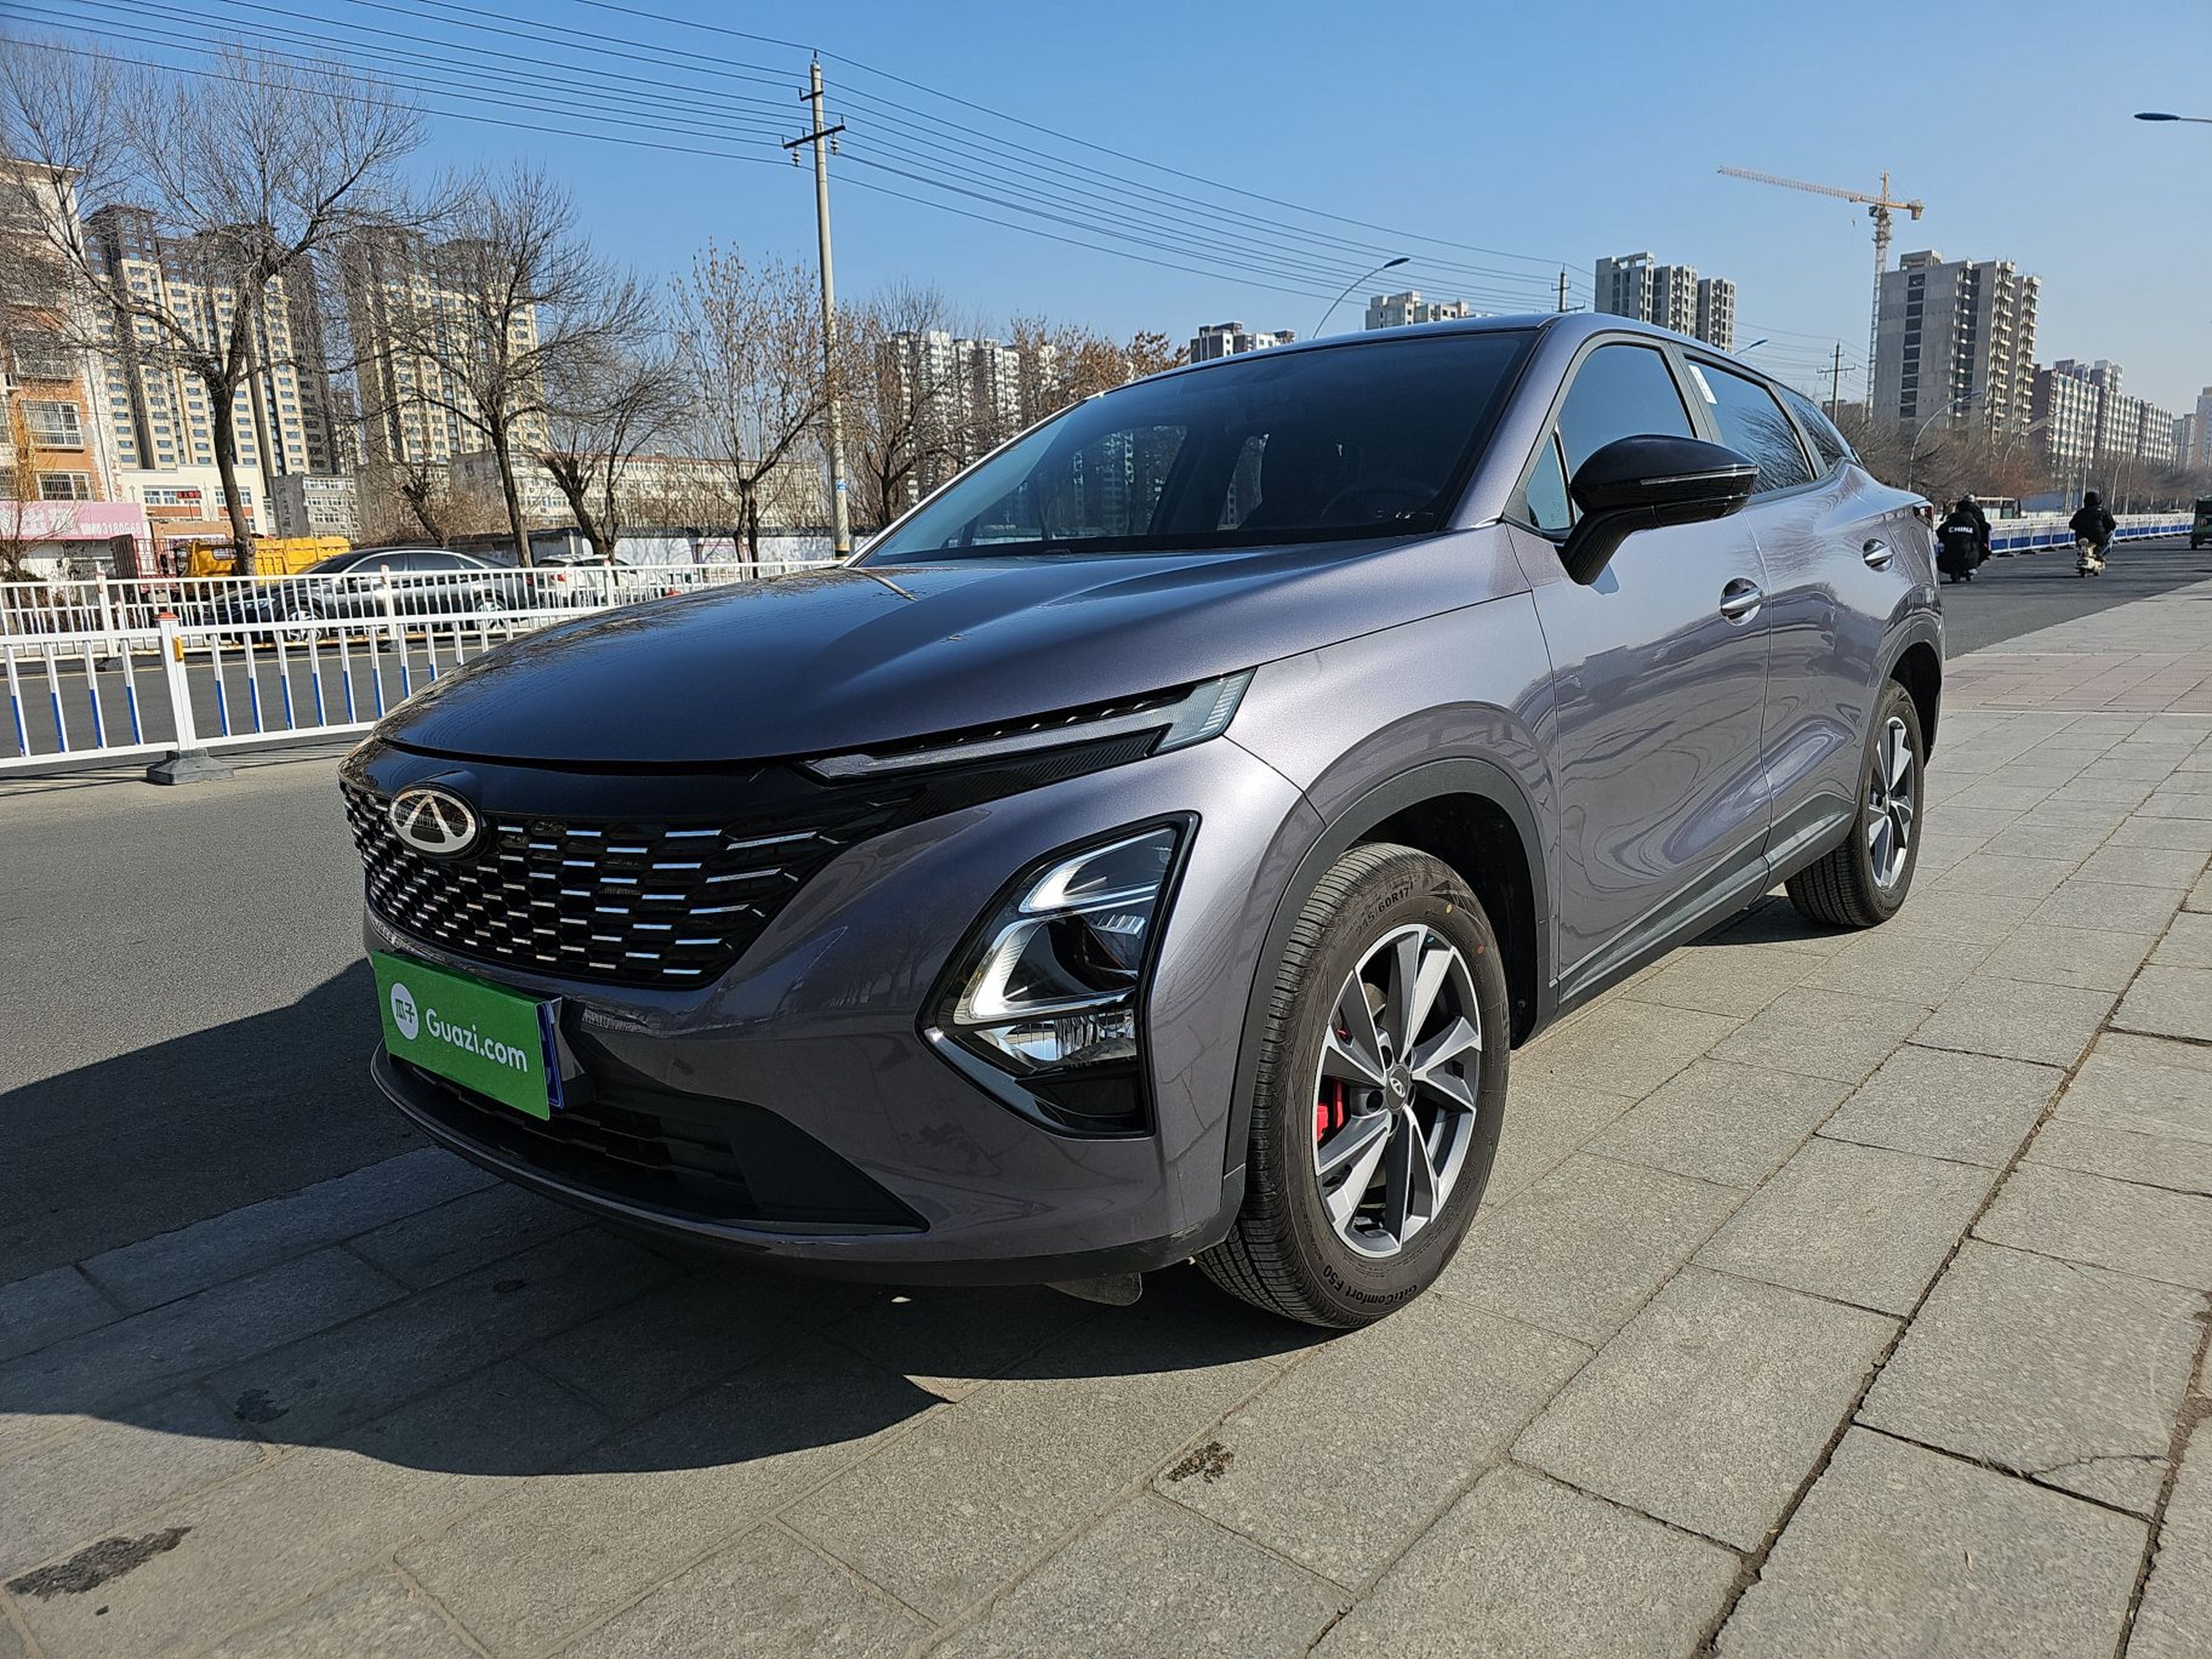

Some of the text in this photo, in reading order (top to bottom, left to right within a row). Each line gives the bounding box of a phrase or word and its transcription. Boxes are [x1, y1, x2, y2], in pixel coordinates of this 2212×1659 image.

[395, 998, 415, 1024] 瓜子
[425, 1008, 528, 1073] Guazi.com
[1322, 1264, 1344, 1292] F50
[1345, 1284, 1418, 1306] GitiComfort
